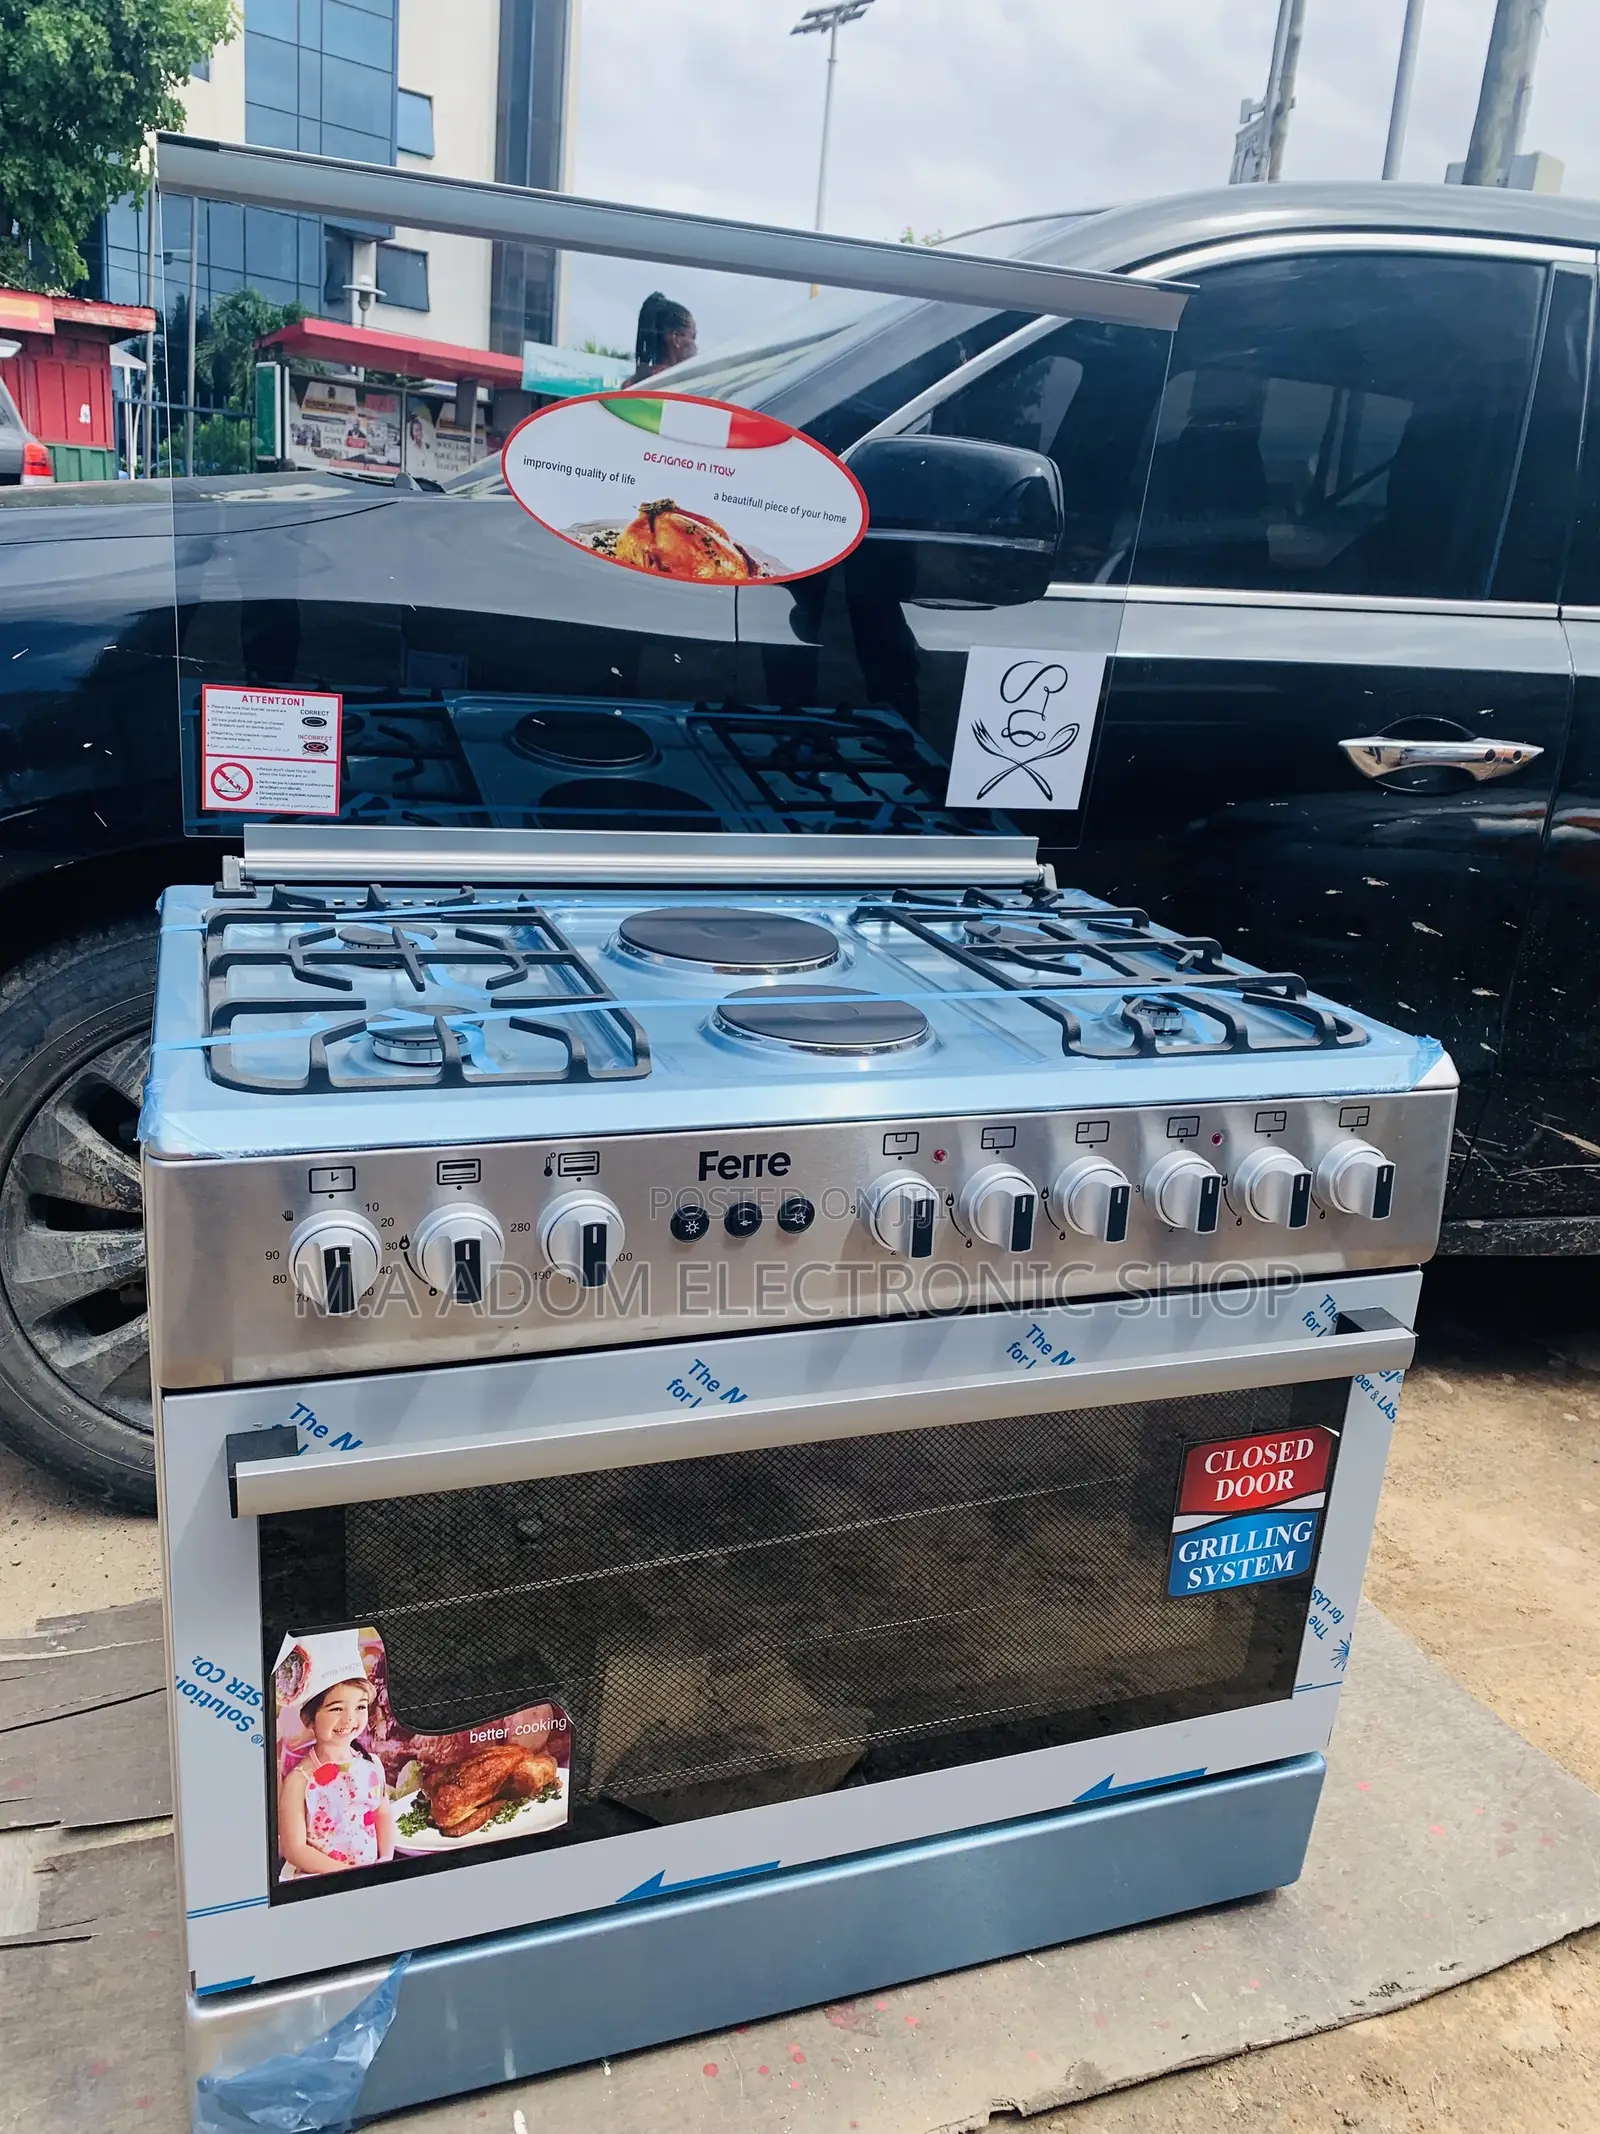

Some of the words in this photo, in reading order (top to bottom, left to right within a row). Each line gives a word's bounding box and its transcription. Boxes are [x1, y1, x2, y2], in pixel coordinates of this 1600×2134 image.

[523, 455, 573, 476] improving
[574, 467, 607, 482] quality
[609, 472, 620, 482] of
[621, 473, 636, 485] life
[643, 452, 693, 469] DESIGNED
[697, 461, 706, 472] IN
[709, 463, 736, 477] ITALY
[713, 492, 719, 500] a
[721, 492, 763, 509] beautifull
[764, 501, 789, 513] piece
[790, 505, 800, 515] of
[801, 508, 821, 519] your
[822, 510, 847, 524] home
[241, 694, 305, 707] ATTENTION!
[698, 1150, 792, 1182] Ferre
[1135, 1184, 1141, 1193] 3
[365, 1202, 380, 1212] 10
[850, 1205, 856, 1214] 3
[380, 1217, 395, 1227] 20
[510, 1222, 531, 1232] 280
[265, 1250, 280, 1260] 90
[385, 1242, 398, 1251] 30
[616, 1252, 633, 1262] 00
[272, 1274, 287, 1284] 80
[379, 1265, 393, 1275] 40
[533, 1270, 552, 1280] 190
[1301, 1310, 1321, 1332] for
[1025, 1323, 1053, 1356] The
[1006, 1341, 1029, 1364] for
[688, 1358, 720, 1393] The
[666, 1378, 694, 1402] for
[289, 1401, 329, 1439] The
[1377, 1395, 1398, 1423] LAS
[1204, 1438, 1314, 1475] CLOSED
[1214, 1469, 1294, 1502] DOOR
[1178, 1520, 1313, 1564] GRILLING
[1186, 1550, 1297, 1590] SYSTEM
[1311, 1586, 1332, 1611] LAS
[1308, 1615, 1329, 1640] The
[1328, 1607, 1345, 1625] for
[225, 1676, 264, 1712] SER
[469, 1727, 510, 1744] better
[515, 1717, 567, 1736] cooking
